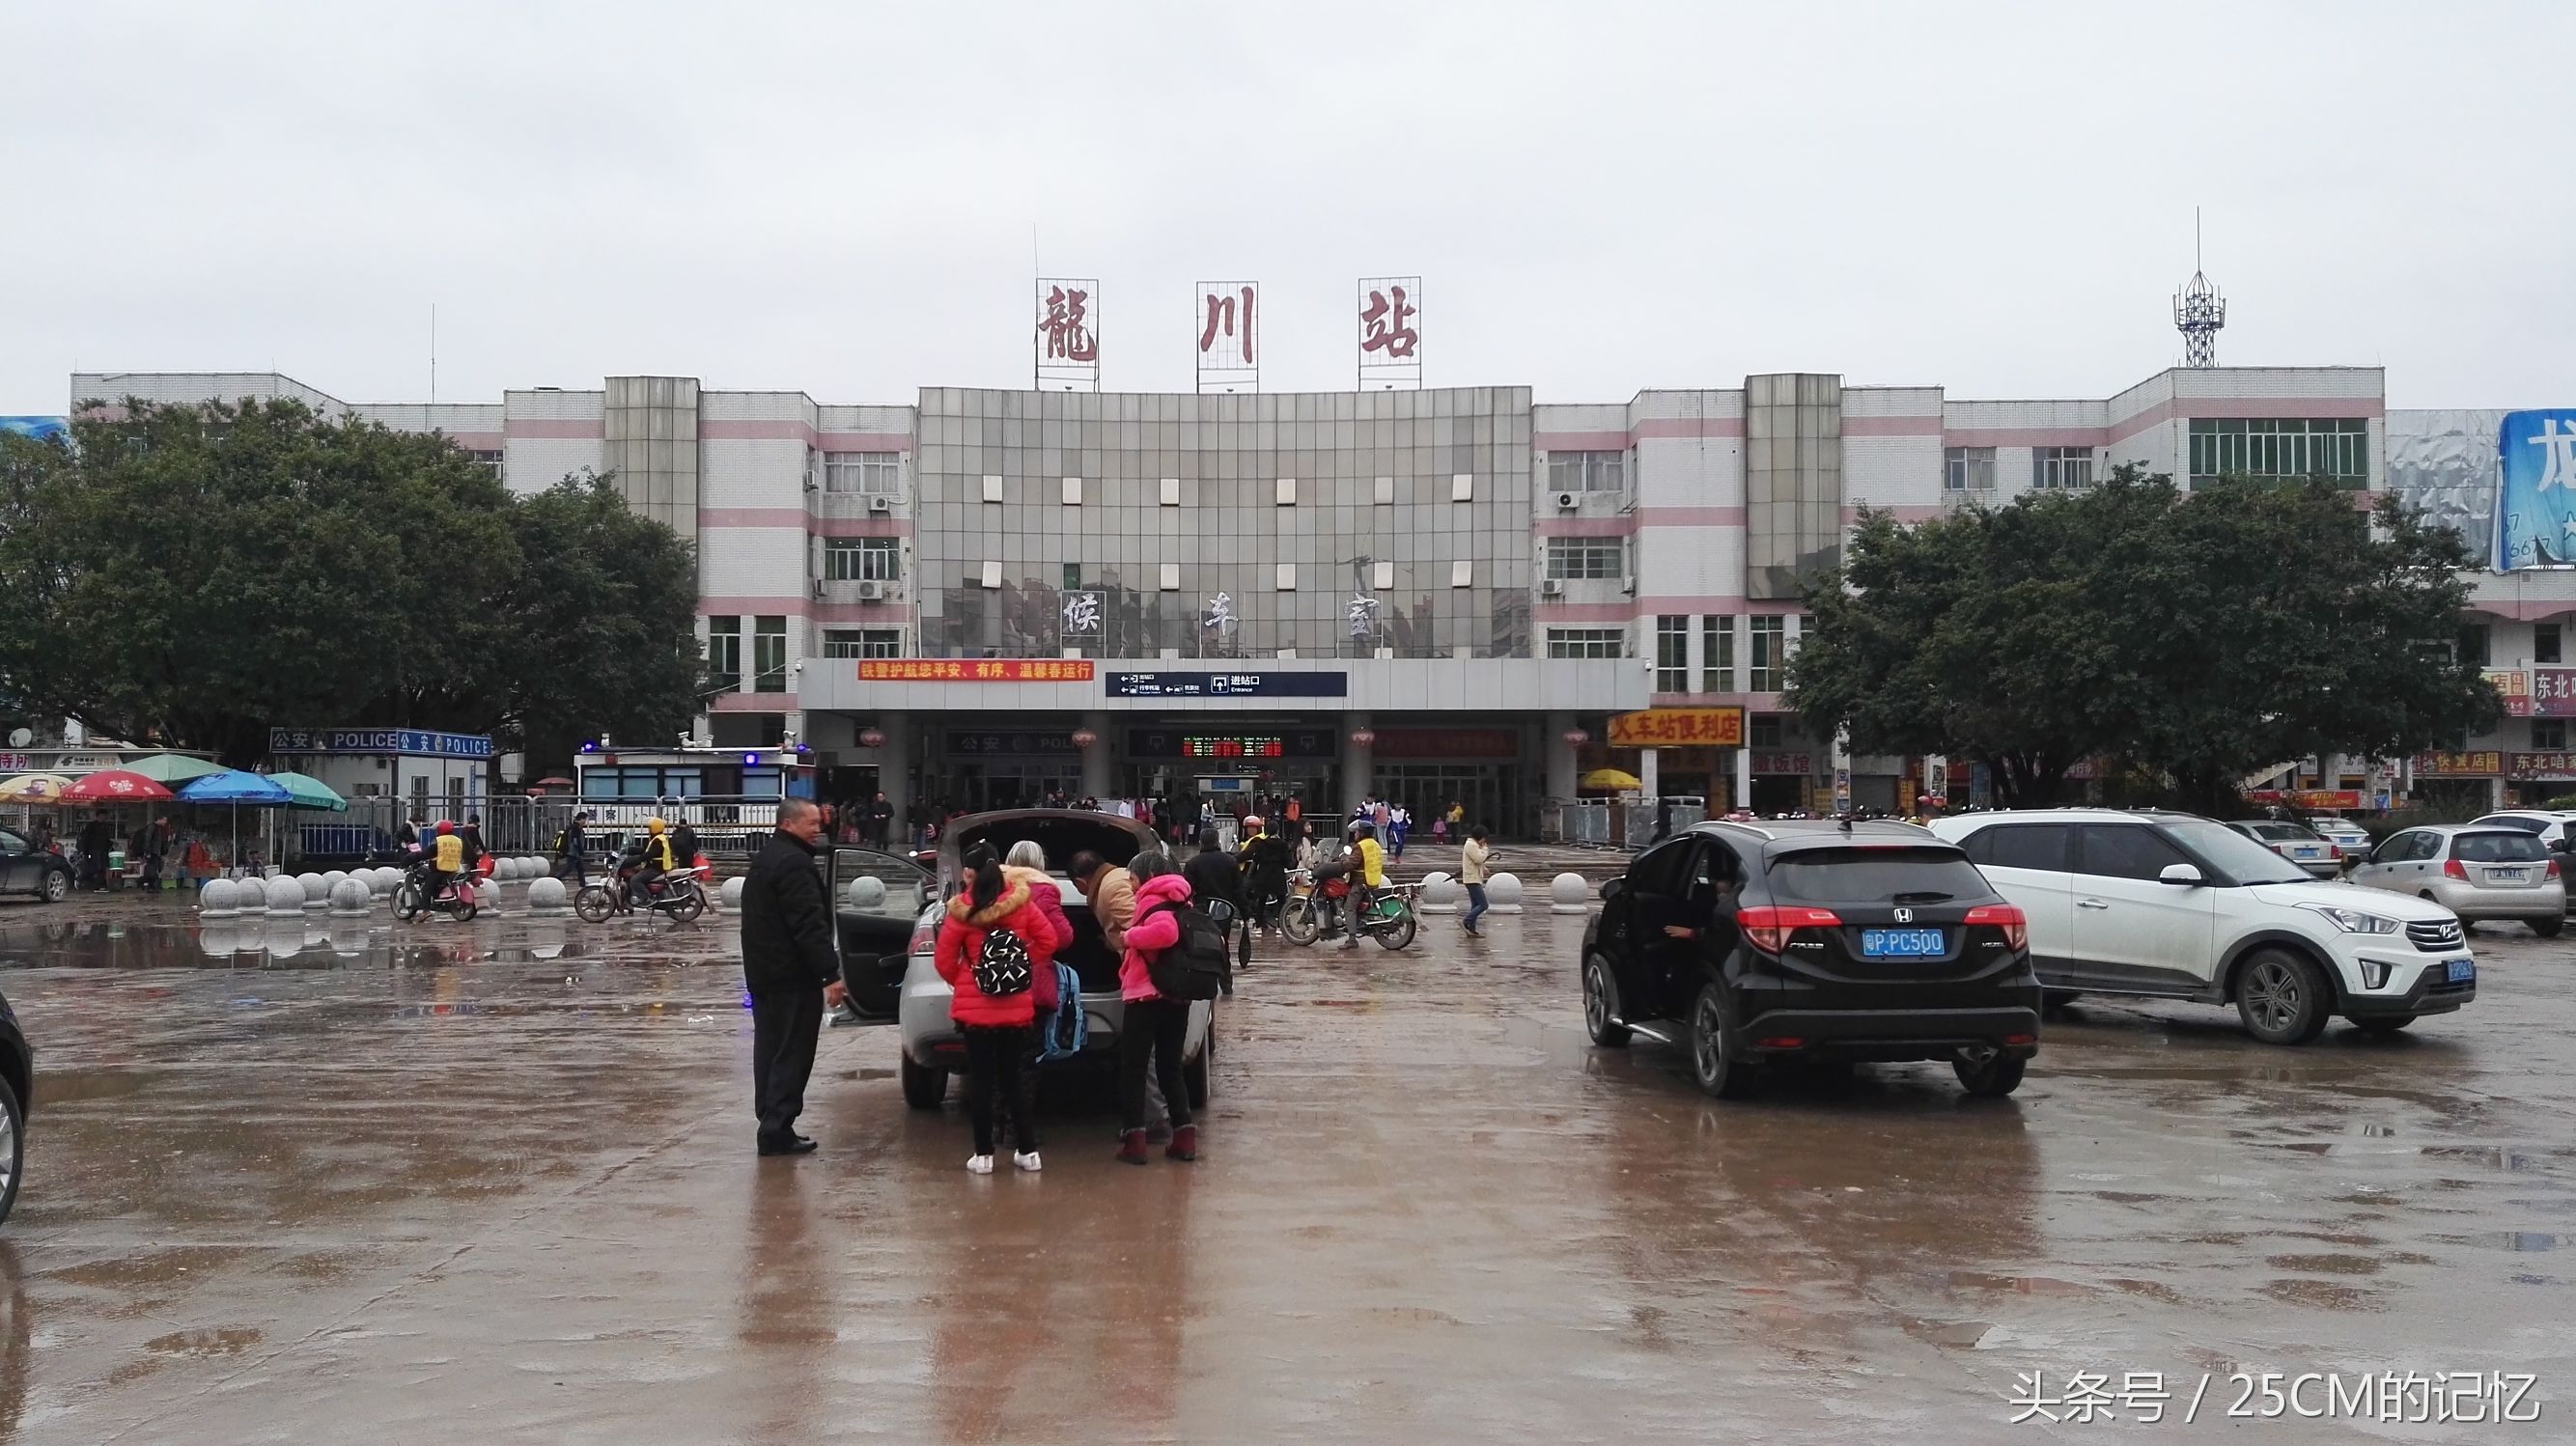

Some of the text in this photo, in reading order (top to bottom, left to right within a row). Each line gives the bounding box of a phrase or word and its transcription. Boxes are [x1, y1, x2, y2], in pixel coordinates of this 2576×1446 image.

[1231, 676, 1259, 685] 进站口
[2536, 674, 2576, 699] 东北
[1610, 713, 1740, 739] 火车站便利店
[274, 733, 397, 747] 公安 POLICE
[401, 734, 489, 754] 公安 POLICE
[962, 737, 1000, 750] 公安
